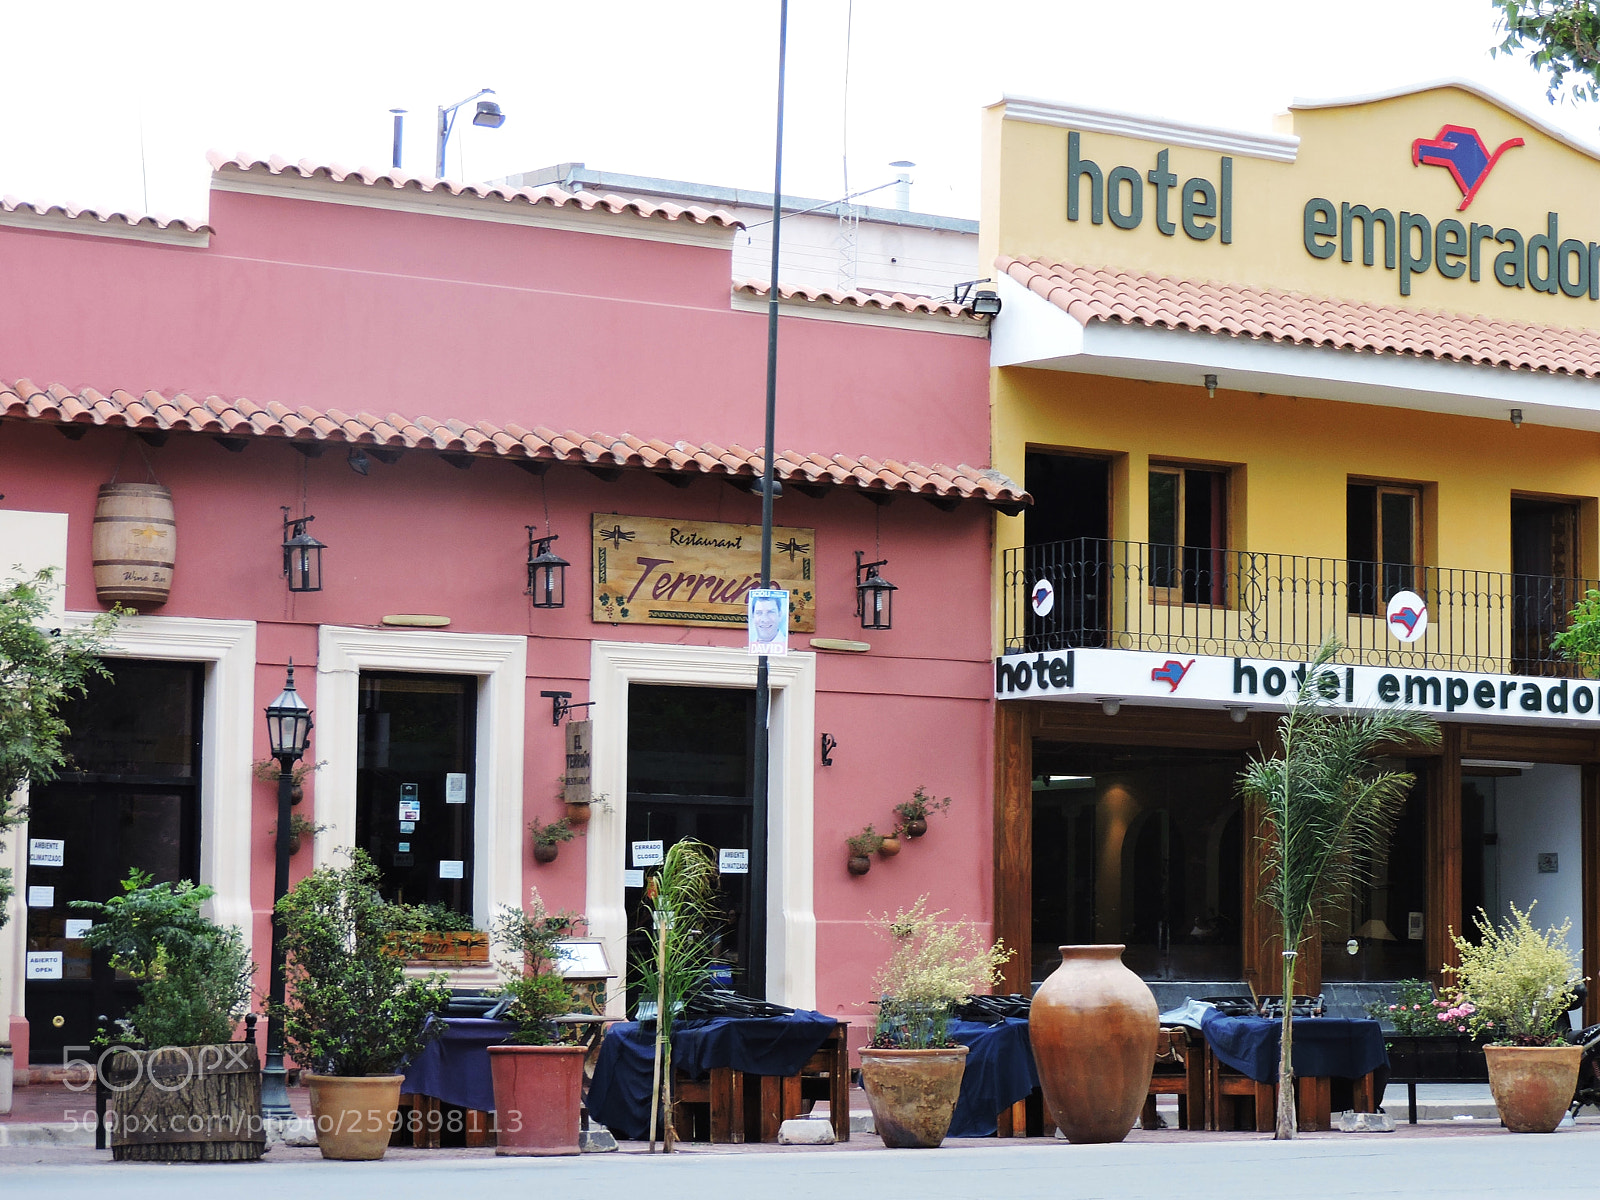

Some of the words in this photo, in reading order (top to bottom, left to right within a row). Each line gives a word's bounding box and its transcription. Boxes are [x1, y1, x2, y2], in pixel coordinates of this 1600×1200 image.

[1067, 130, 1232, 244] hotel
[670, 527, 742, 550] Restaurant
[123, 570, 148, 581] Wine
[152, 572, 166, 583] Bar
[750, 643, 783, 654] DAVID
[996, 650, 1074, 692] hotel
[1233, 657, 1354, 702] hotel
[1377, 673, 1600, 714] emperado
[574, 735, 582, 749] EL
[34, 842, 59, 850] AMBIENTE
[30, 853, 62, 862] CLIMATIZADO
[724, 851, 745, 859] AMBIENTE
[721, 862, 748, 870] CLIMATIZADO
